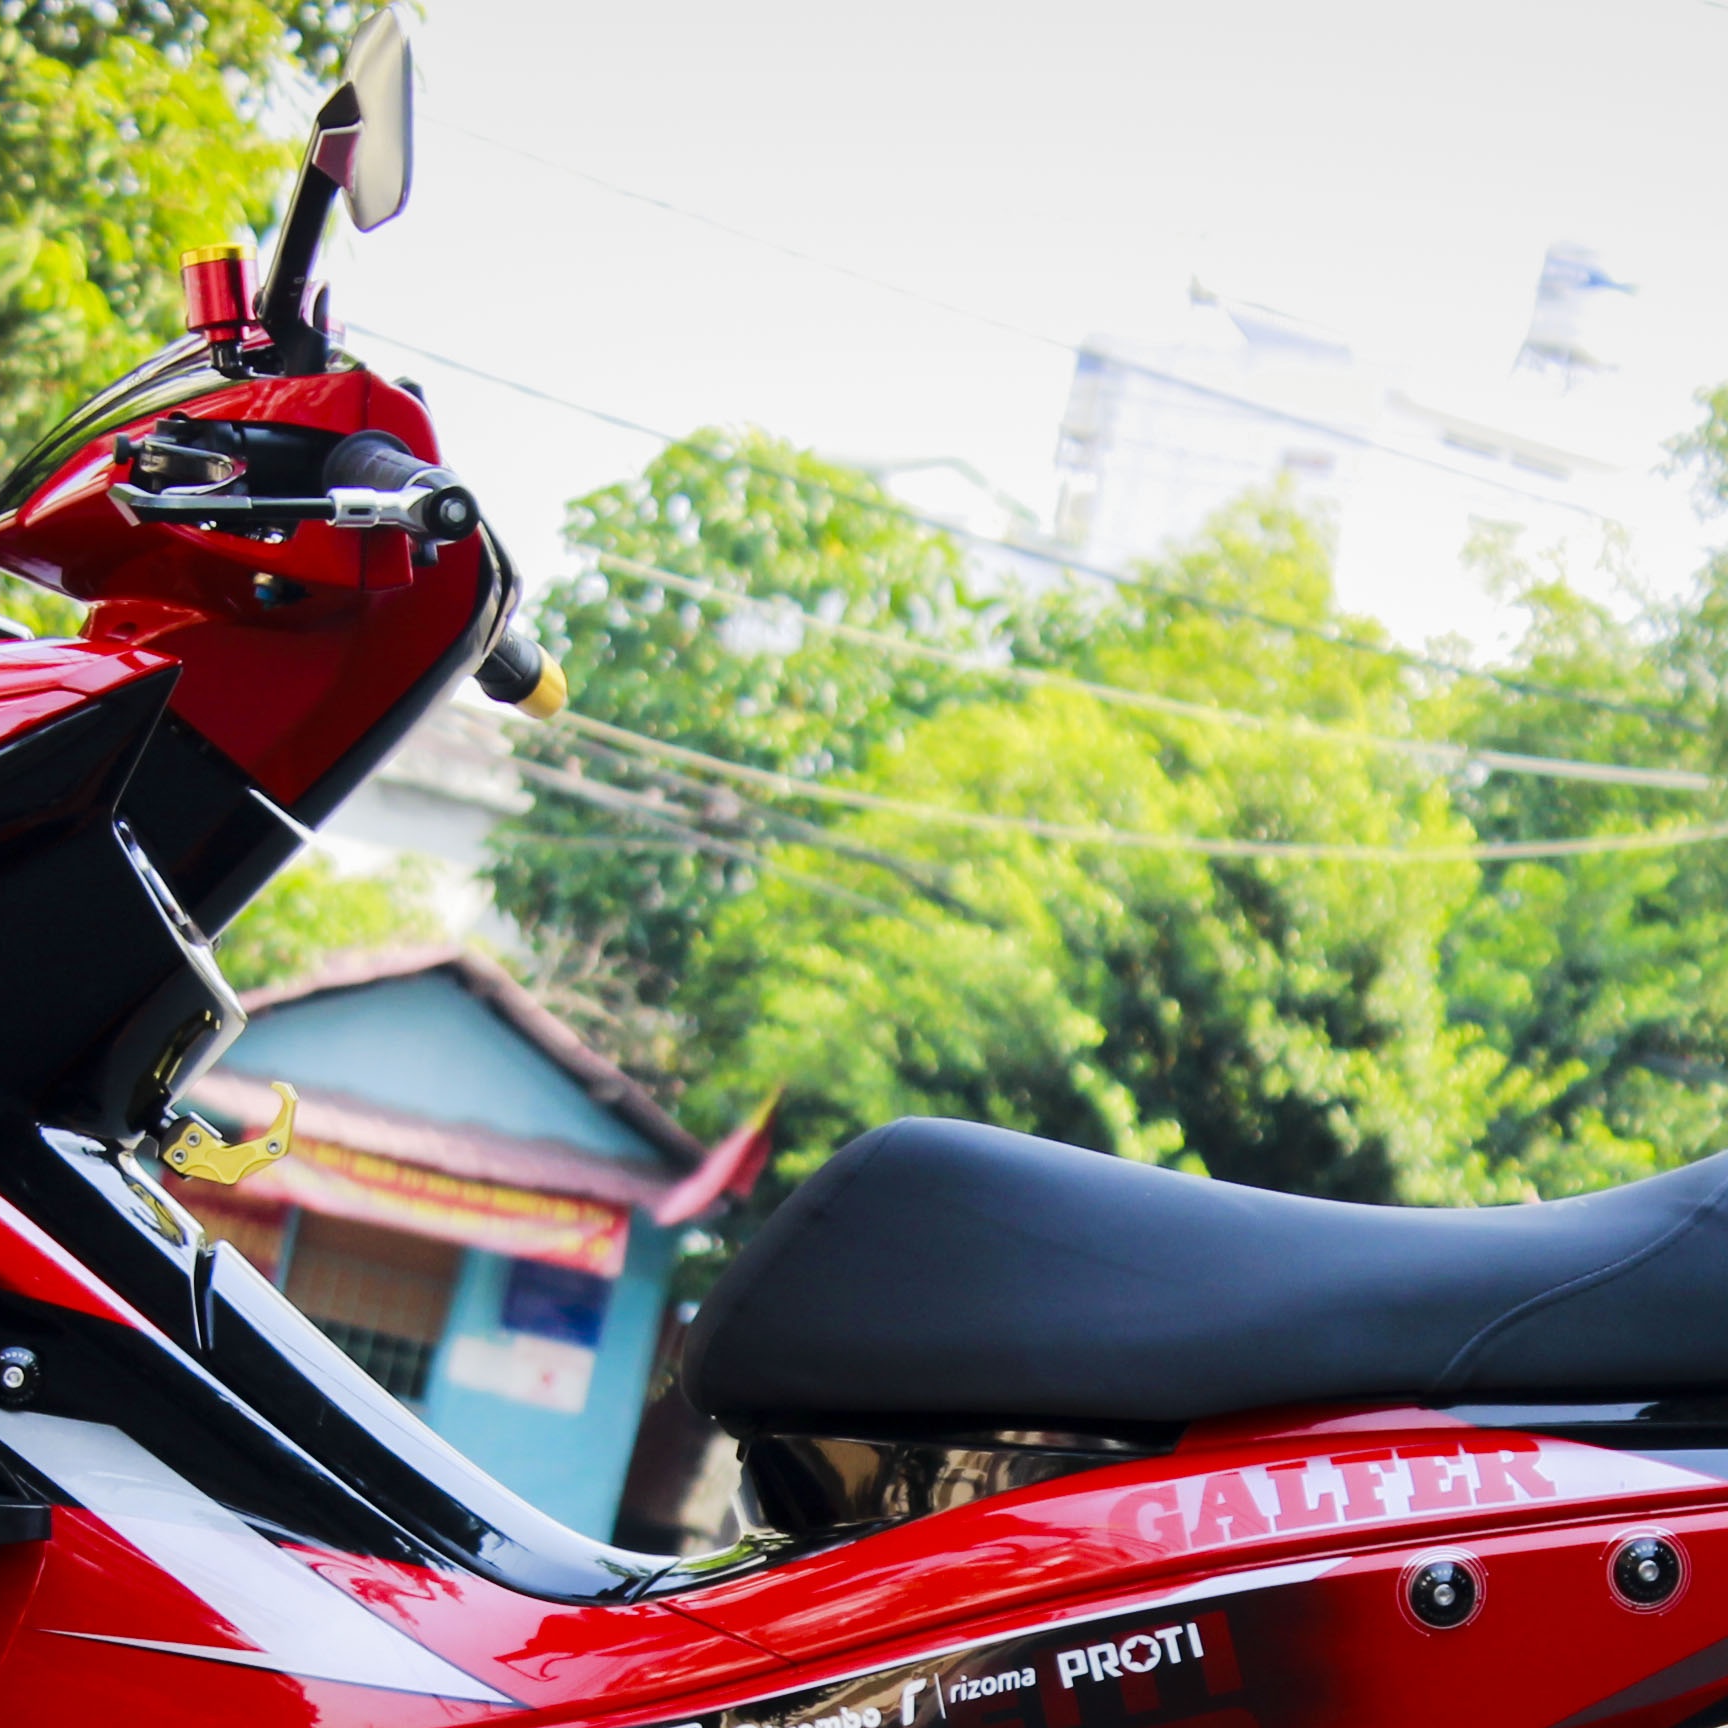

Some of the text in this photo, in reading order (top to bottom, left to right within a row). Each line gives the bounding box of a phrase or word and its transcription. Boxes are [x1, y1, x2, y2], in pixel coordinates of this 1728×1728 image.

[1106, 1438, 1557, 1561] GALFER
[949, 1667, 1037, 1704] rizoma
[1057, 1622, 1205, 1689] PROTI
